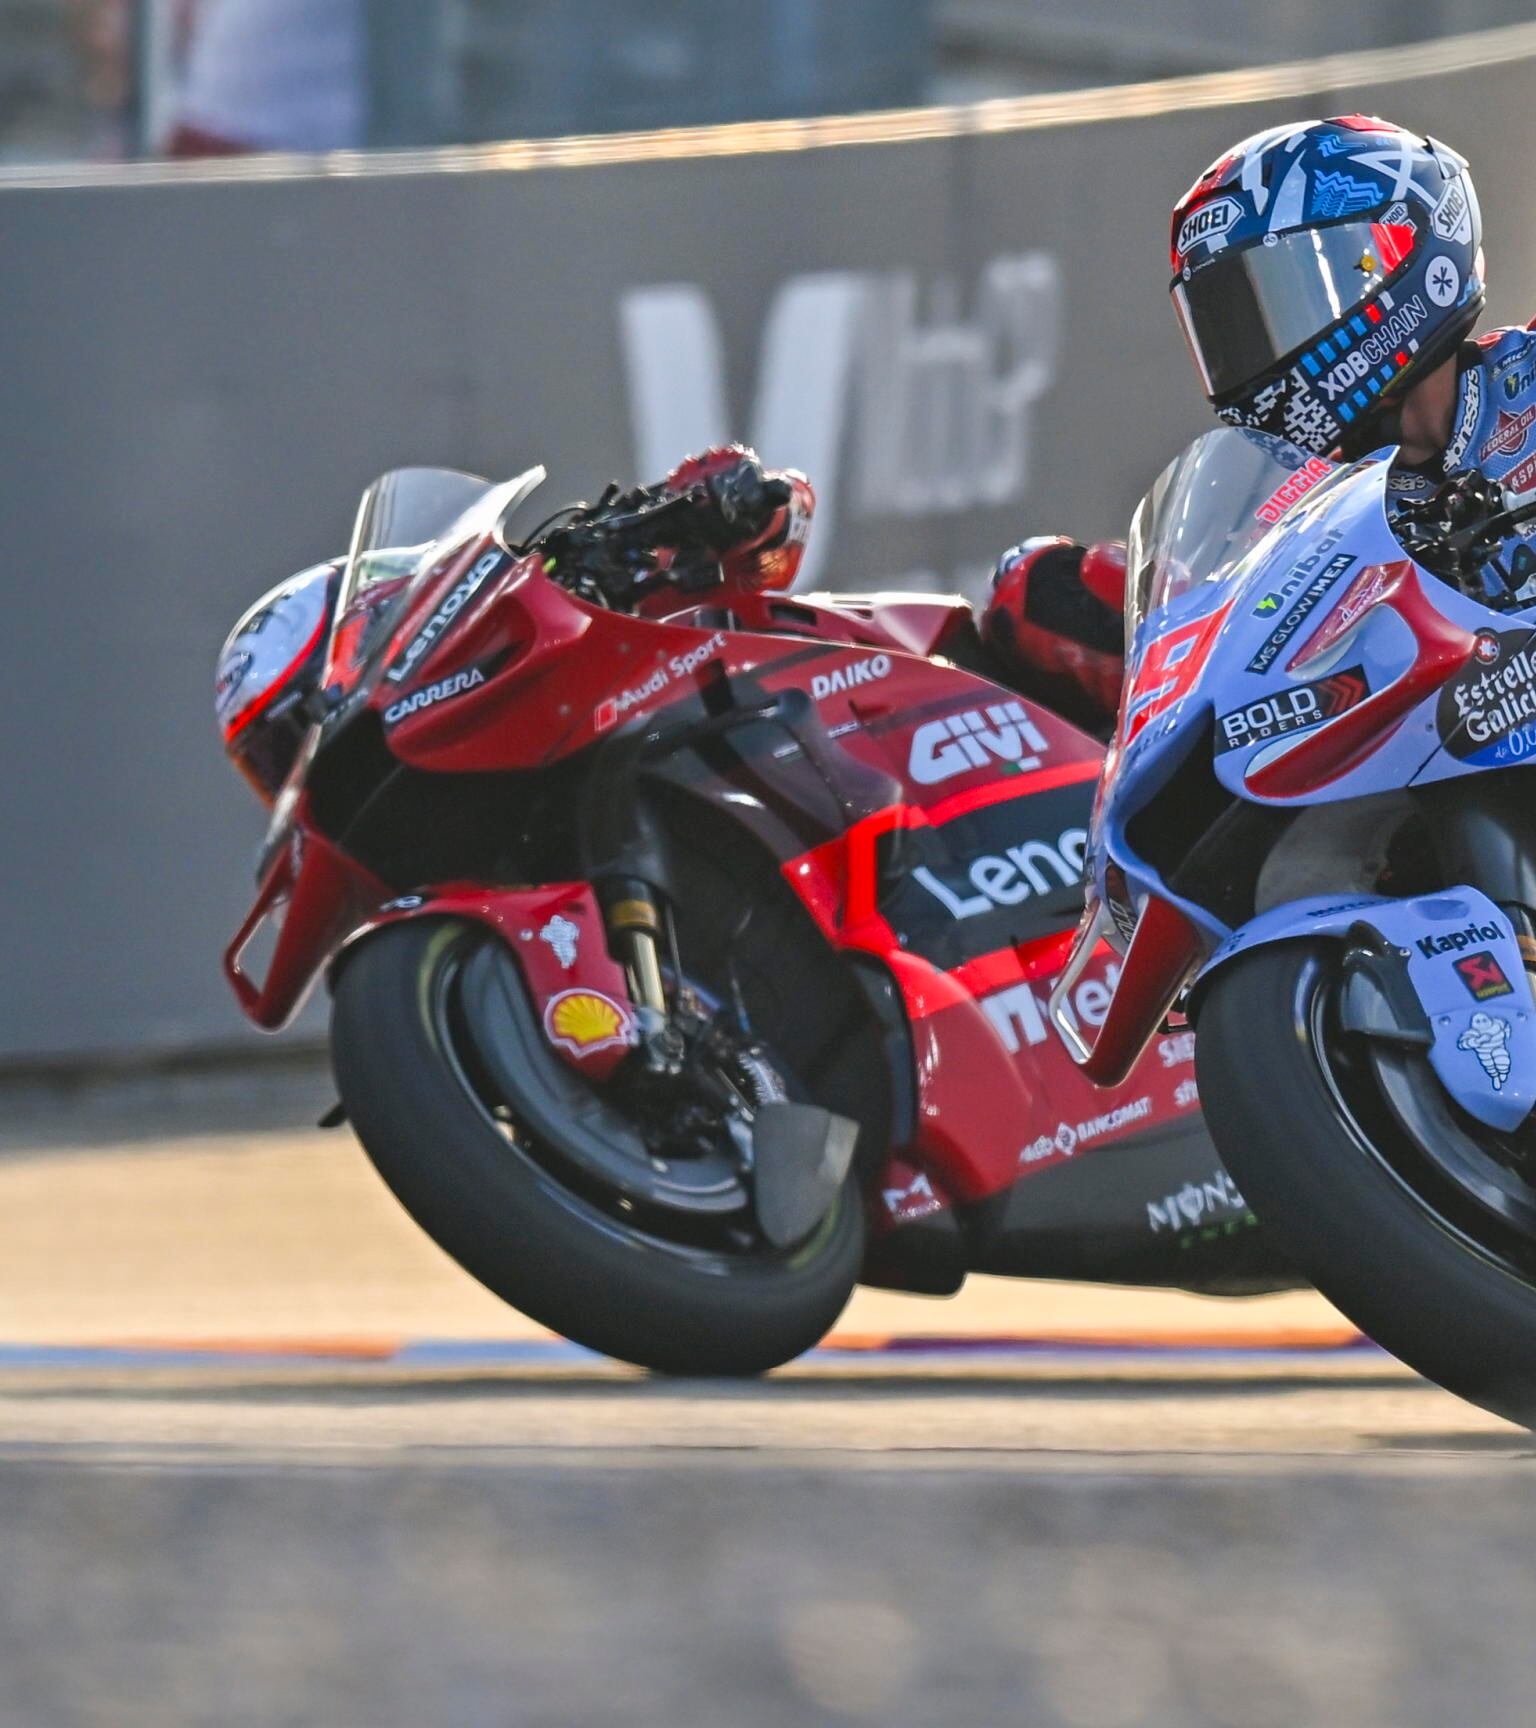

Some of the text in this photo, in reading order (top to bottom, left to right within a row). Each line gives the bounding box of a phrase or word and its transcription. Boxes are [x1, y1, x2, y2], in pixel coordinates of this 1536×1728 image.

[1180, 204, 1229, 244] SHOEI
[1438, 188, 1465, 233] SHOEI
[1319, 295, 1428, 401] XDBCHAIN
[1482, 412, 1535, 458] FEDERAL OIL
[1255, 455, 1333, 524] DIGGIA
[1252, 529, 1345, 619] Unibat
[387, 550, 501, 682] Lenovo
[1272, 597, 1314, 644] GLOW
[384, 667, 485, 724] CARRERA
[616, 632, 728, 711] Audi Sport
[811, 654, 892, 700] DAIKO
[1221, 686, 1317, 739] BOLD
[1228, 708, 1323, 748] RIDERS
[908, 701, 1049, 785] GIVI
[1415, 921, 1506, 960] Kapriol
